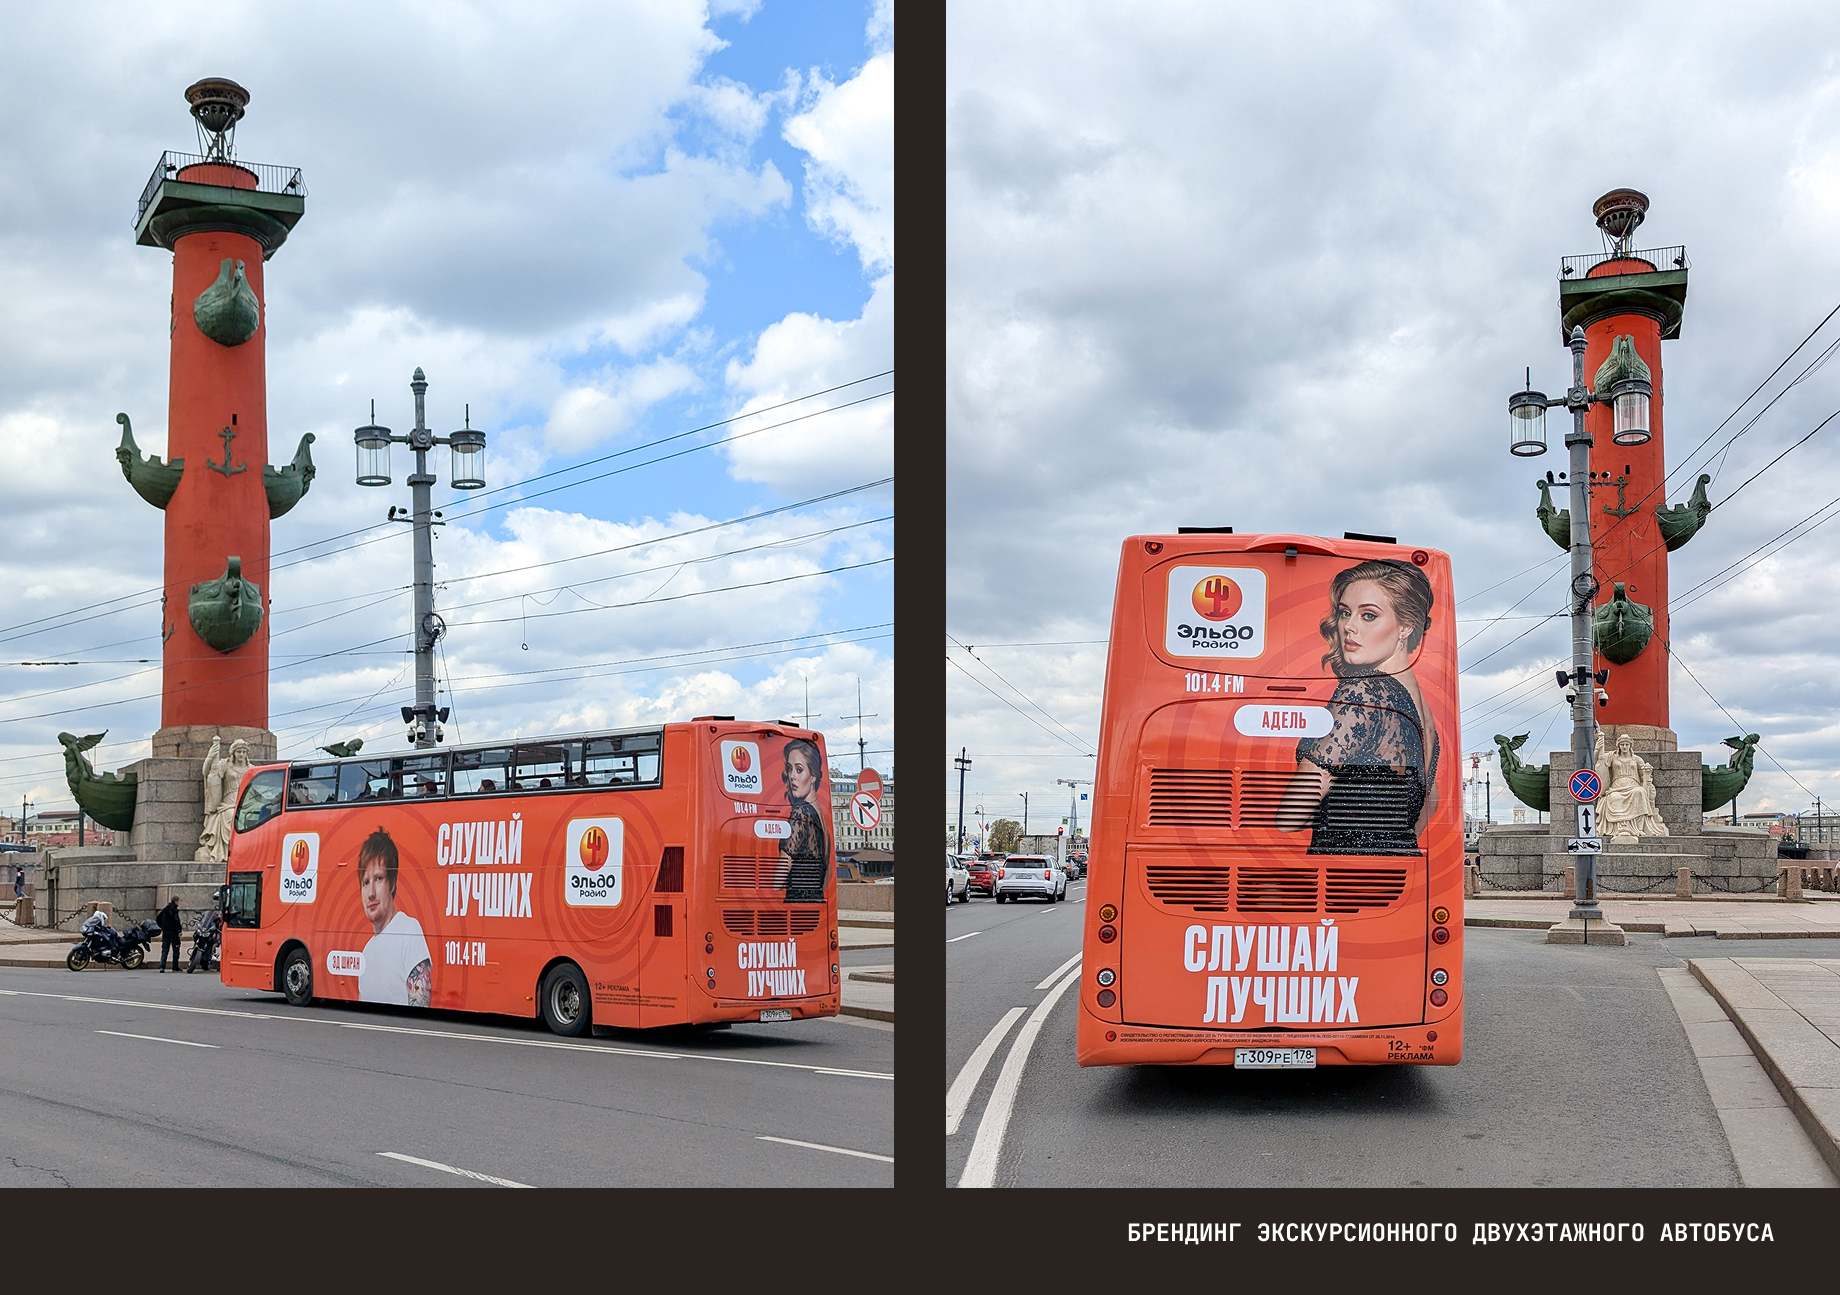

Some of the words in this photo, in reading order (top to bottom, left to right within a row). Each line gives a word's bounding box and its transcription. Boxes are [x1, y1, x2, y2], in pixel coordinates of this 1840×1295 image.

[1184, 672, 1221, 692] 101.4
[1224, 674, 1244, 693] FM
[1261, 710, 1307, 730] АДЕЛЬ
[734, 802, 748, 814] 101.4
[749, 803, 758, 814] FM
[437, 812, 523, 866] СЛУШАЙ
[764, 824, 782, 834] АДЕЛЬ
[445, 872, 533, 918] ЛУЧШИХ
[445, 941, 469, 965] 101.4
[472, 942, 486, 966] FM
[738, 938, 797, 970] СЛУШАЙ
[1184, 918, 1338, 972] СЛУШАЙ
[333, 956, 340, 970] ЭД
[341, 956, 360, 970] ШИРАН
[748, 970, 807, 997] ЛУЧШИХ
[1202, 976, 1360, 1023] ЛУЧШИХ
[1293, 1050, 1312, 1059] 178
[1388, 1040, 1411, 1050] 12+
